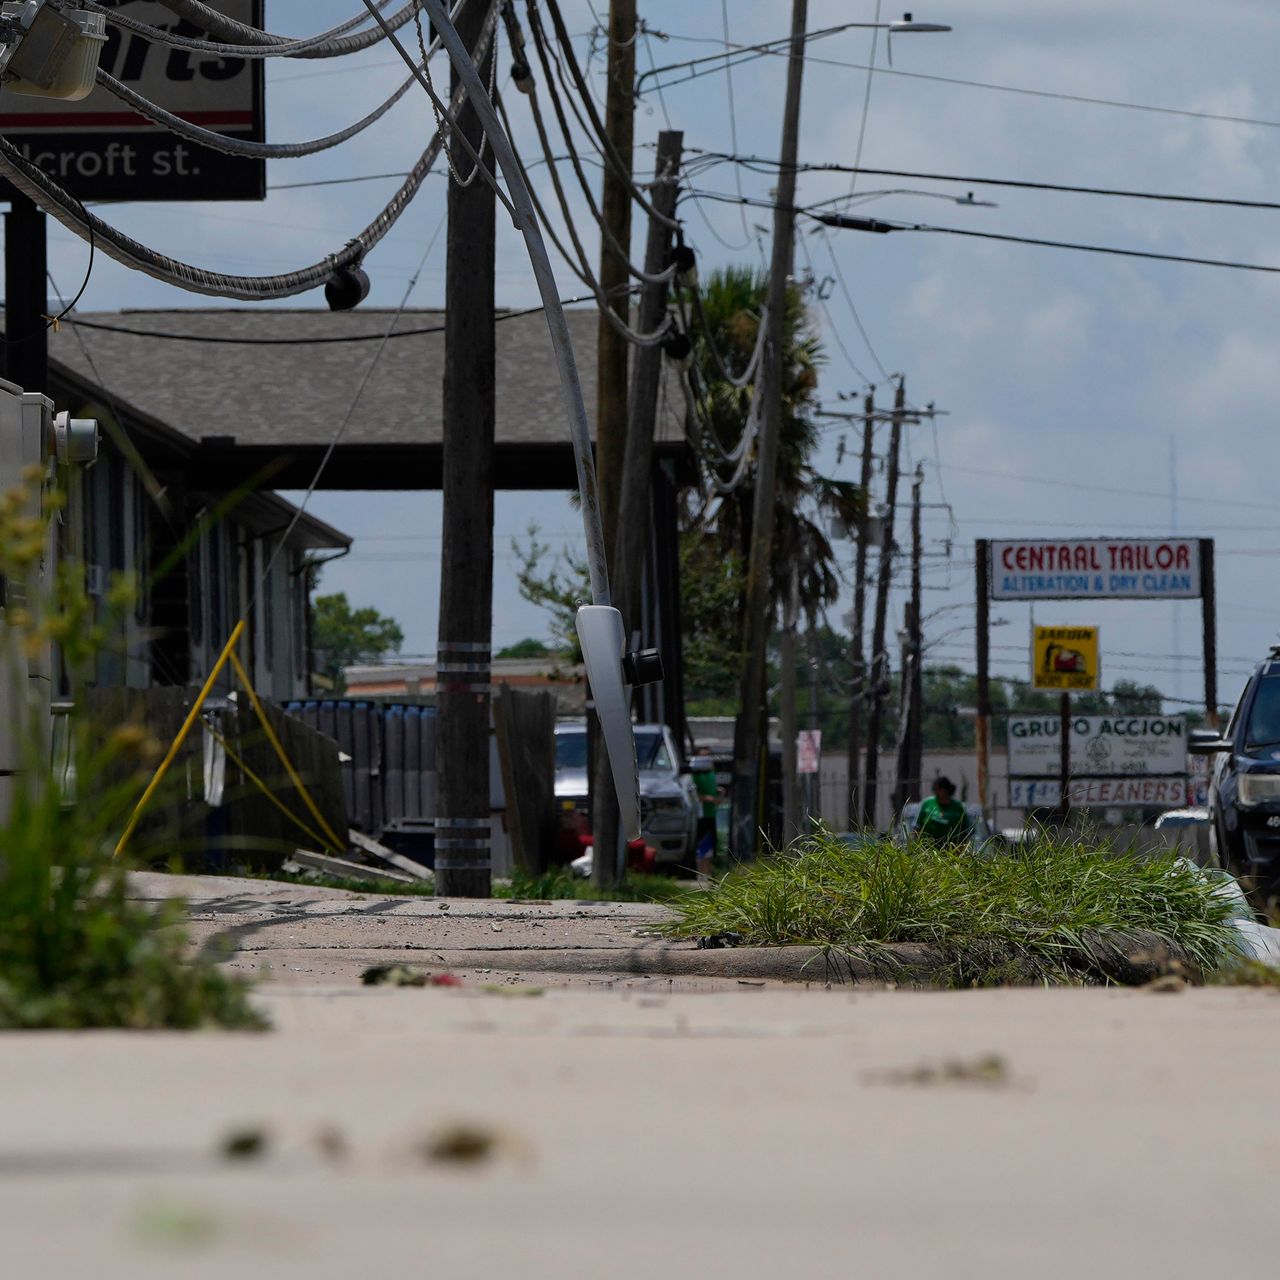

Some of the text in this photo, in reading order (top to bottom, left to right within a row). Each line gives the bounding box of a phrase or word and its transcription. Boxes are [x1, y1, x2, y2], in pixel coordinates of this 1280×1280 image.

[151, 143, 201, 177] st.
[1002, 544, 1190, 571] CENTRAL TAILOR
[1002, 574, 1191, 592] ALTERATION & DRY CLEAN
[1012, 719, 1182, 737] GRUO ACCION
[1070, 782, 1182, 802] CLEANERS
